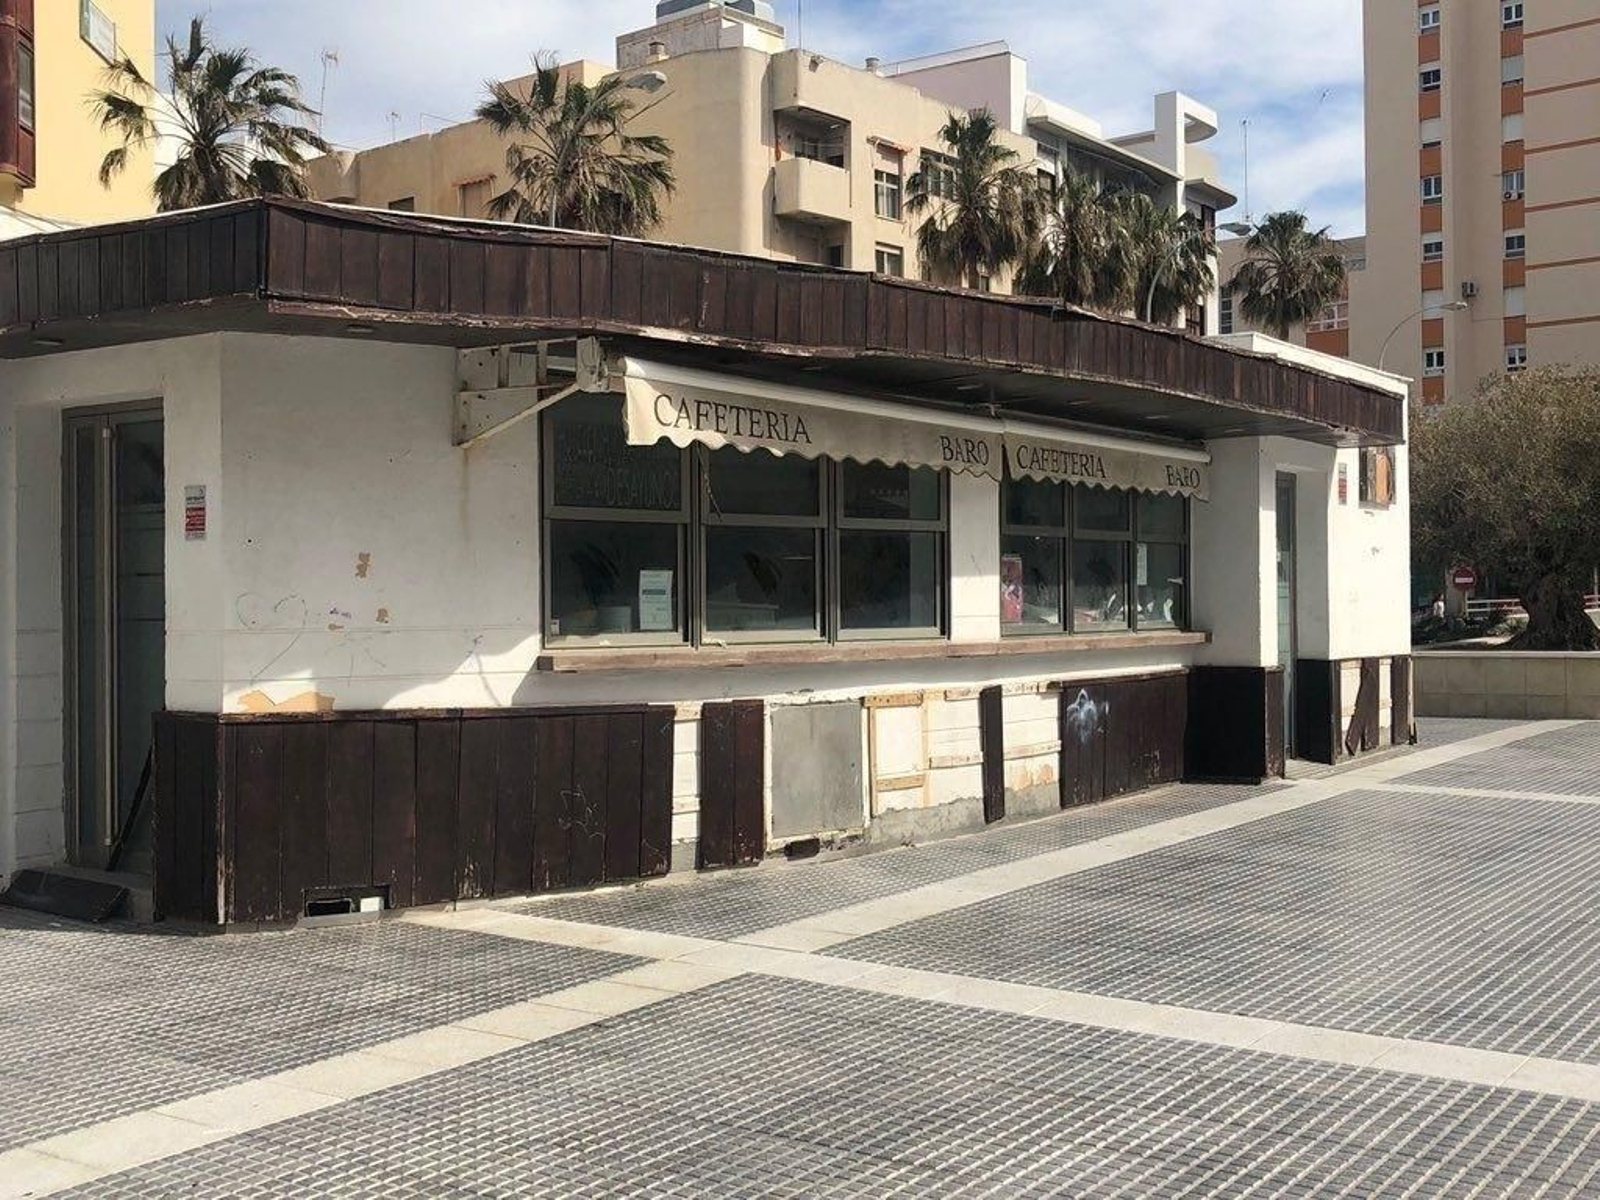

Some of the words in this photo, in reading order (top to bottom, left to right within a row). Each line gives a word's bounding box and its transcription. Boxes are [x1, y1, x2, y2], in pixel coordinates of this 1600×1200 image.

[654, 393, 813, 444] CAFETERIA
[939, 435, 990, 466] BARO
[1016, 444, 1107, 479] CAFETERIA
